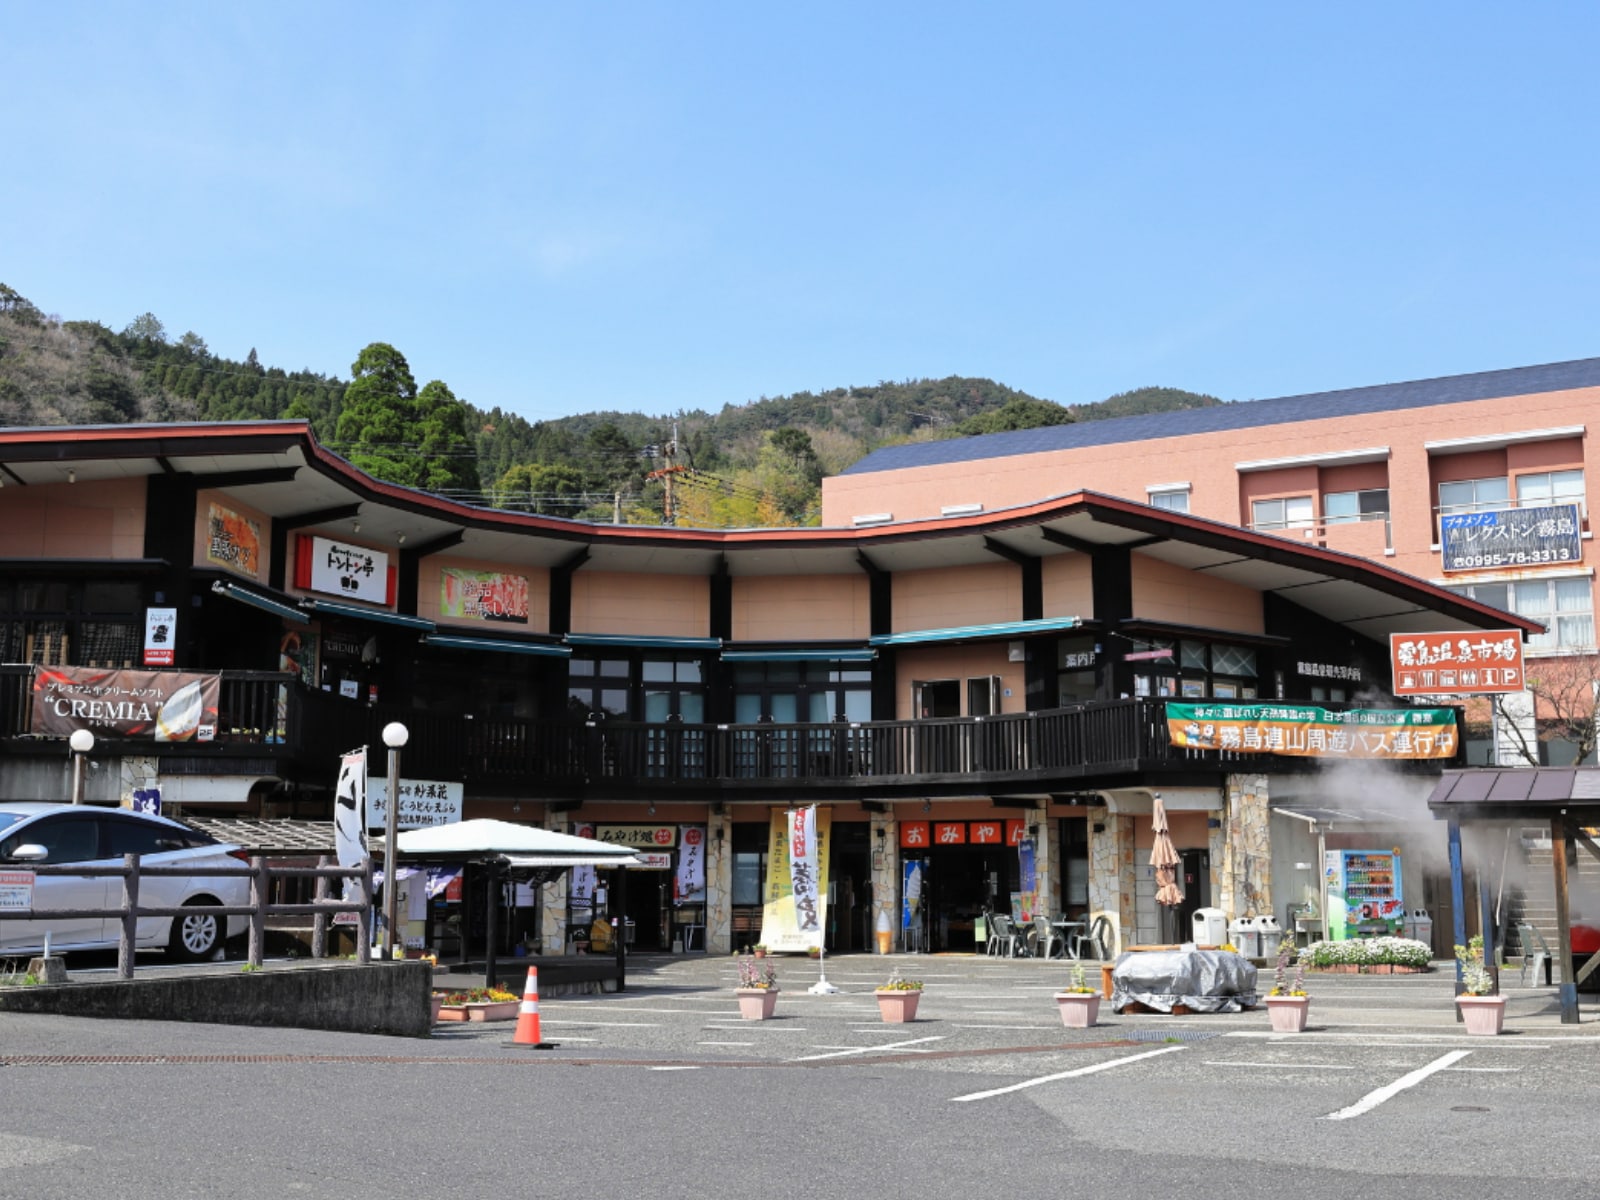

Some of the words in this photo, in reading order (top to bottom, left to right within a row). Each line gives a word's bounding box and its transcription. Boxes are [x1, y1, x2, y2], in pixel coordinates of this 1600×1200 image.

[1445, 514, 1493, 528] プチメゾン
[327, 552, 375, 578] トントン亭
[1465, 548, 1570, 567] 0995-78-3313
[1397, 637, 1518, 667] 霧島温泉市場
[47, 682, 164, 699] プレミアム生クリームソフト
[1219, 725, 1454, 754] 霧島連山周遊バス運行中
